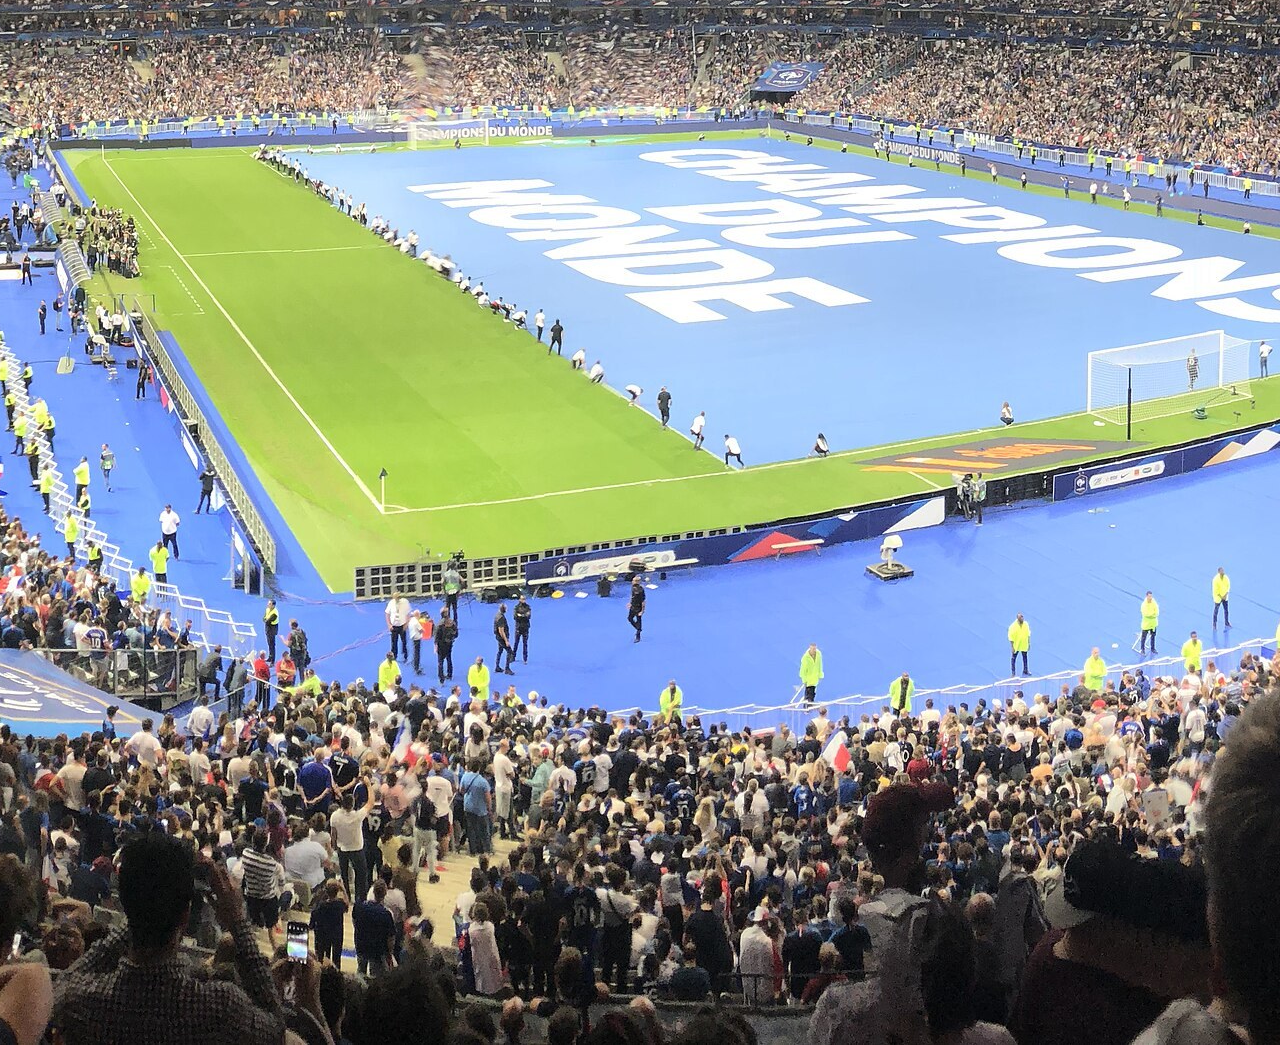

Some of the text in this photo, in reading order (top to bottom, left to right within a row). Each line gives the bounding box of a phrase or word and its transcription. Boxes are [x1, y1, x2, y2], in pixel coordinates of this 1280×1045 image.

[489, 126, 506, 137] DU
[508, 125, 553, 137] MONDE
[920, 147, 931, 159] DU
[931, 148, 960, 165] MONDE
[643, 198, 918, 249] DU
[405, 178, 873, 324] MONDE
[336, 762, 344, 776] 7
